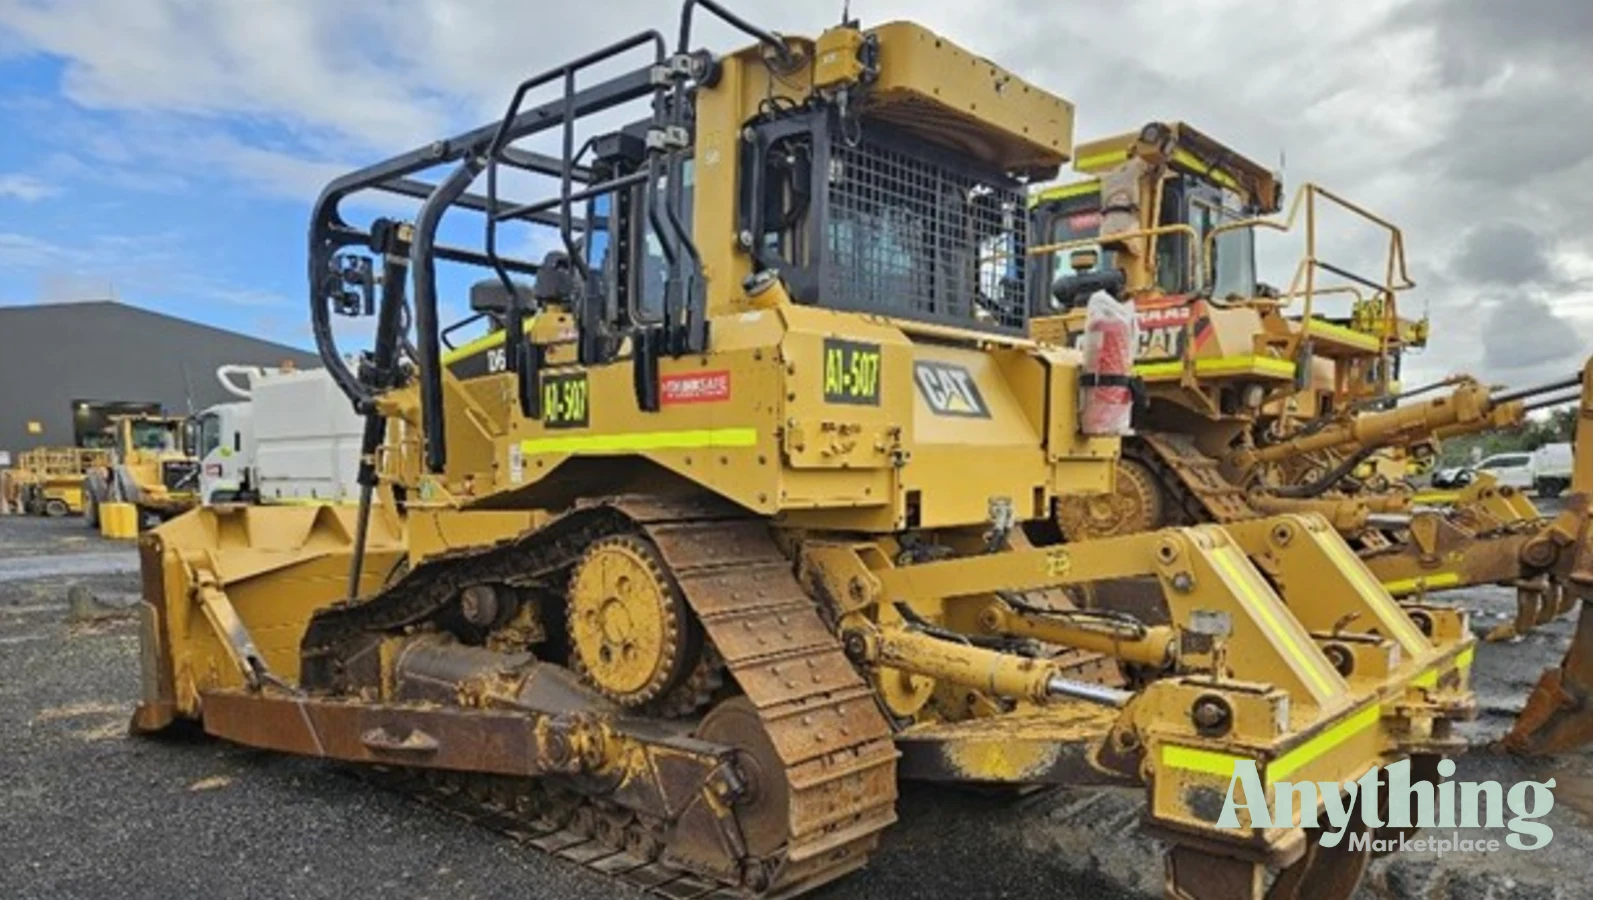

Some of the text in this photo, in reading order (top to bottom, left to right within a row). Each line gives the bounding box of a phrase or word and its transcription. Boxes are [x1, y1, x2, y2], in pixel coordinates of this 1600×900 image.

[826, 349, 879, 397] A1-507
[916, 365, 982, 414] CAT
[544, 381, 586, 421] A1-507
